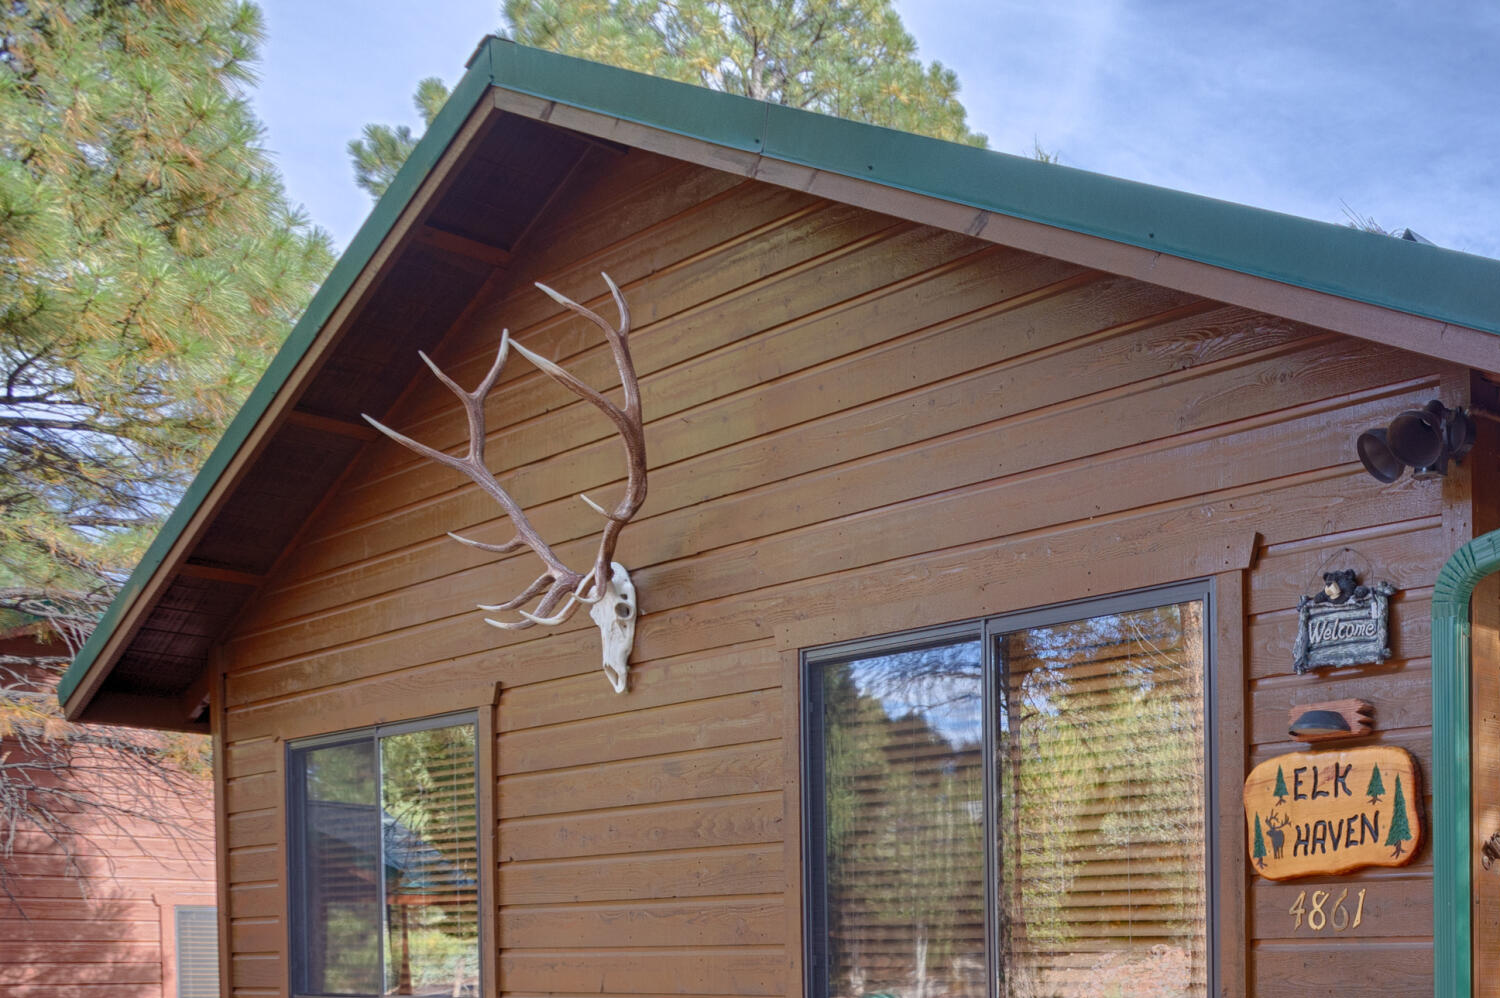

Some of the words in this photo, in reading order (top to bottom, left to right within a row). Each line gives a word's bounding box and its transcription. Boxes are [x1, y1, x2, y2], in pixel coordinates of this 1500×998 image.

[1308, 618, 1377, 643] Welcome
[1293, 762, 1353, 801] ELK
[1293, 810, 1380, 857] HAVEN
[1288, 888, 1366, 932] 4861
